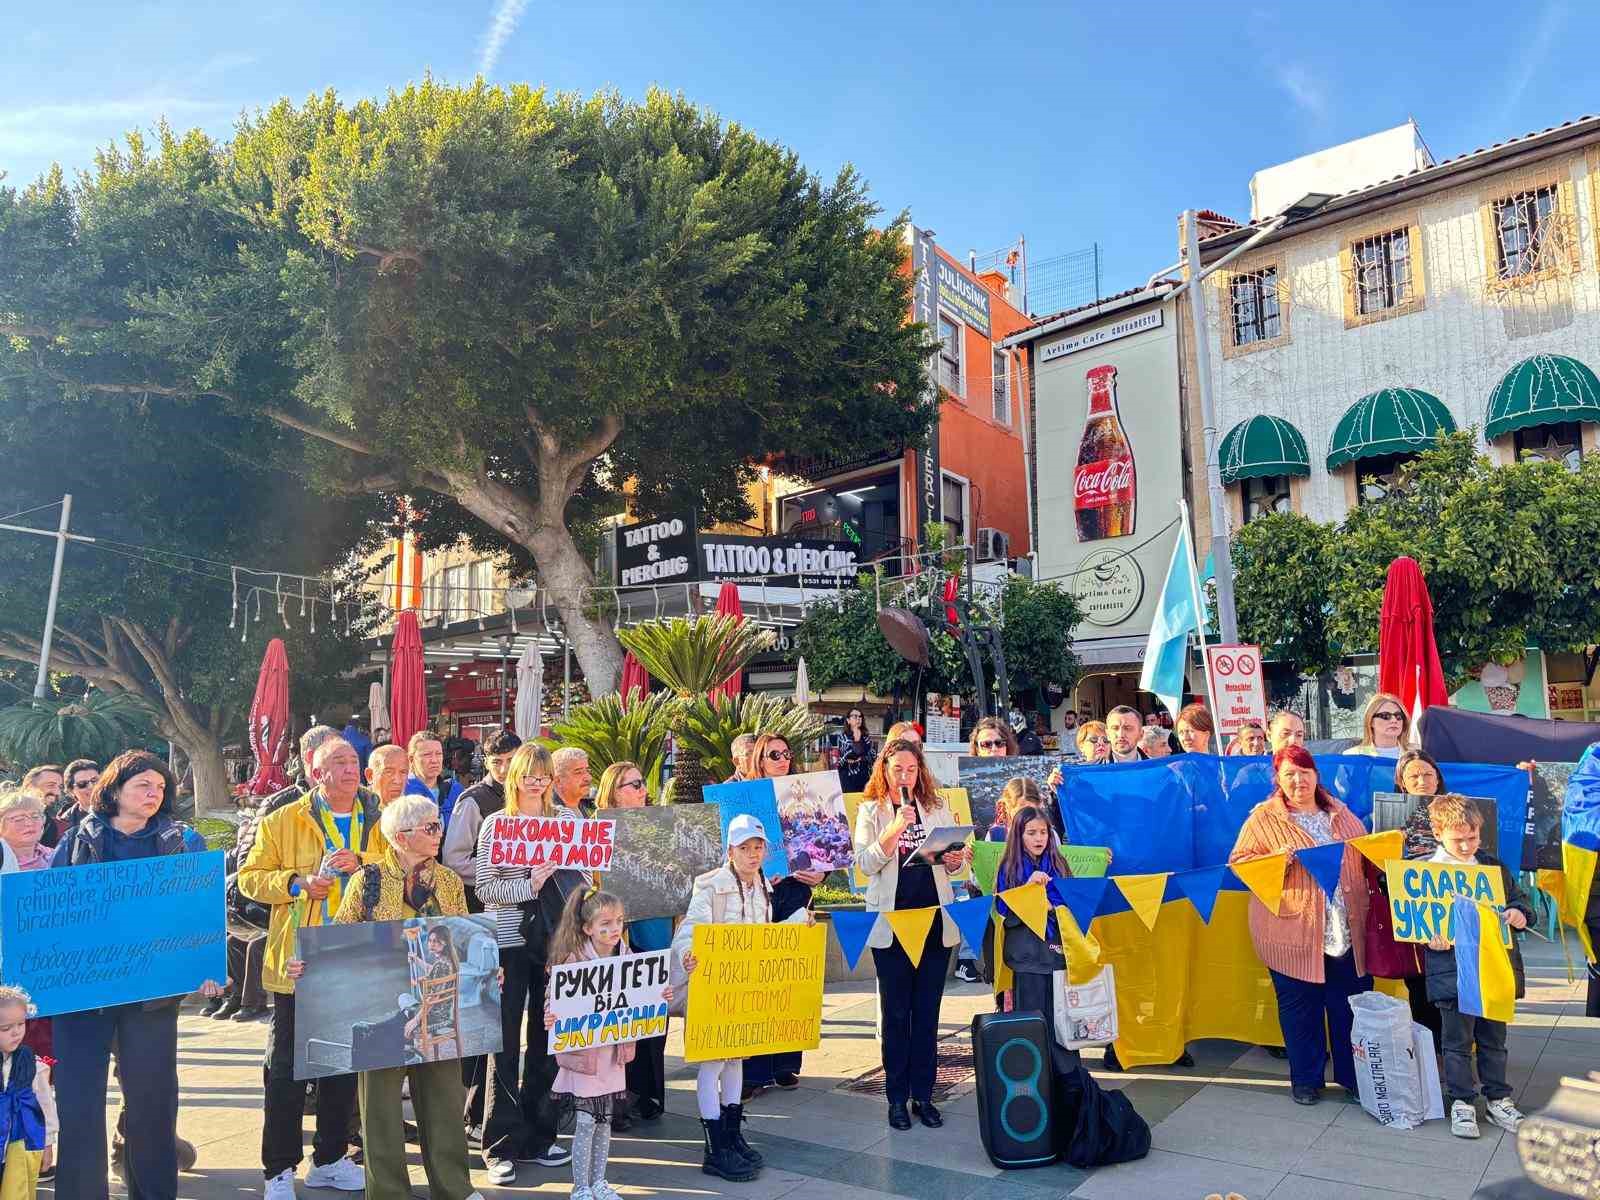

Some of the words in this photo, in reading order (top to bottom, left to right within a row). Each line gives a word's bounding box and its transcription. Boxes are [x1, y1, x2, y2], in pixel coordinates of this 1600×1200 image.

[624, 519, 683, 547] TATTOO
[648, 545, 661, 561] &
[703, 544, 770, 574] TATTOO
[773, 548, 786, 574] &
[622, 556, 688, 586] PIERCING
[581, 821, 613, 845] НЕ
[1404, 868, 1494, 901] СЛАВА
[705, 928, 715, 952] 4
[722, 928, 753, 952] РОКИ
[555, 963, 614, 1000] РУКИ
[620, 955, 668, 990] ГЕТЬ
[703, 960, 713, 984] 4
[719, 960, 750, 984] РОКИ
[553, 1002, 668, 1051] УКРАЇНИ
